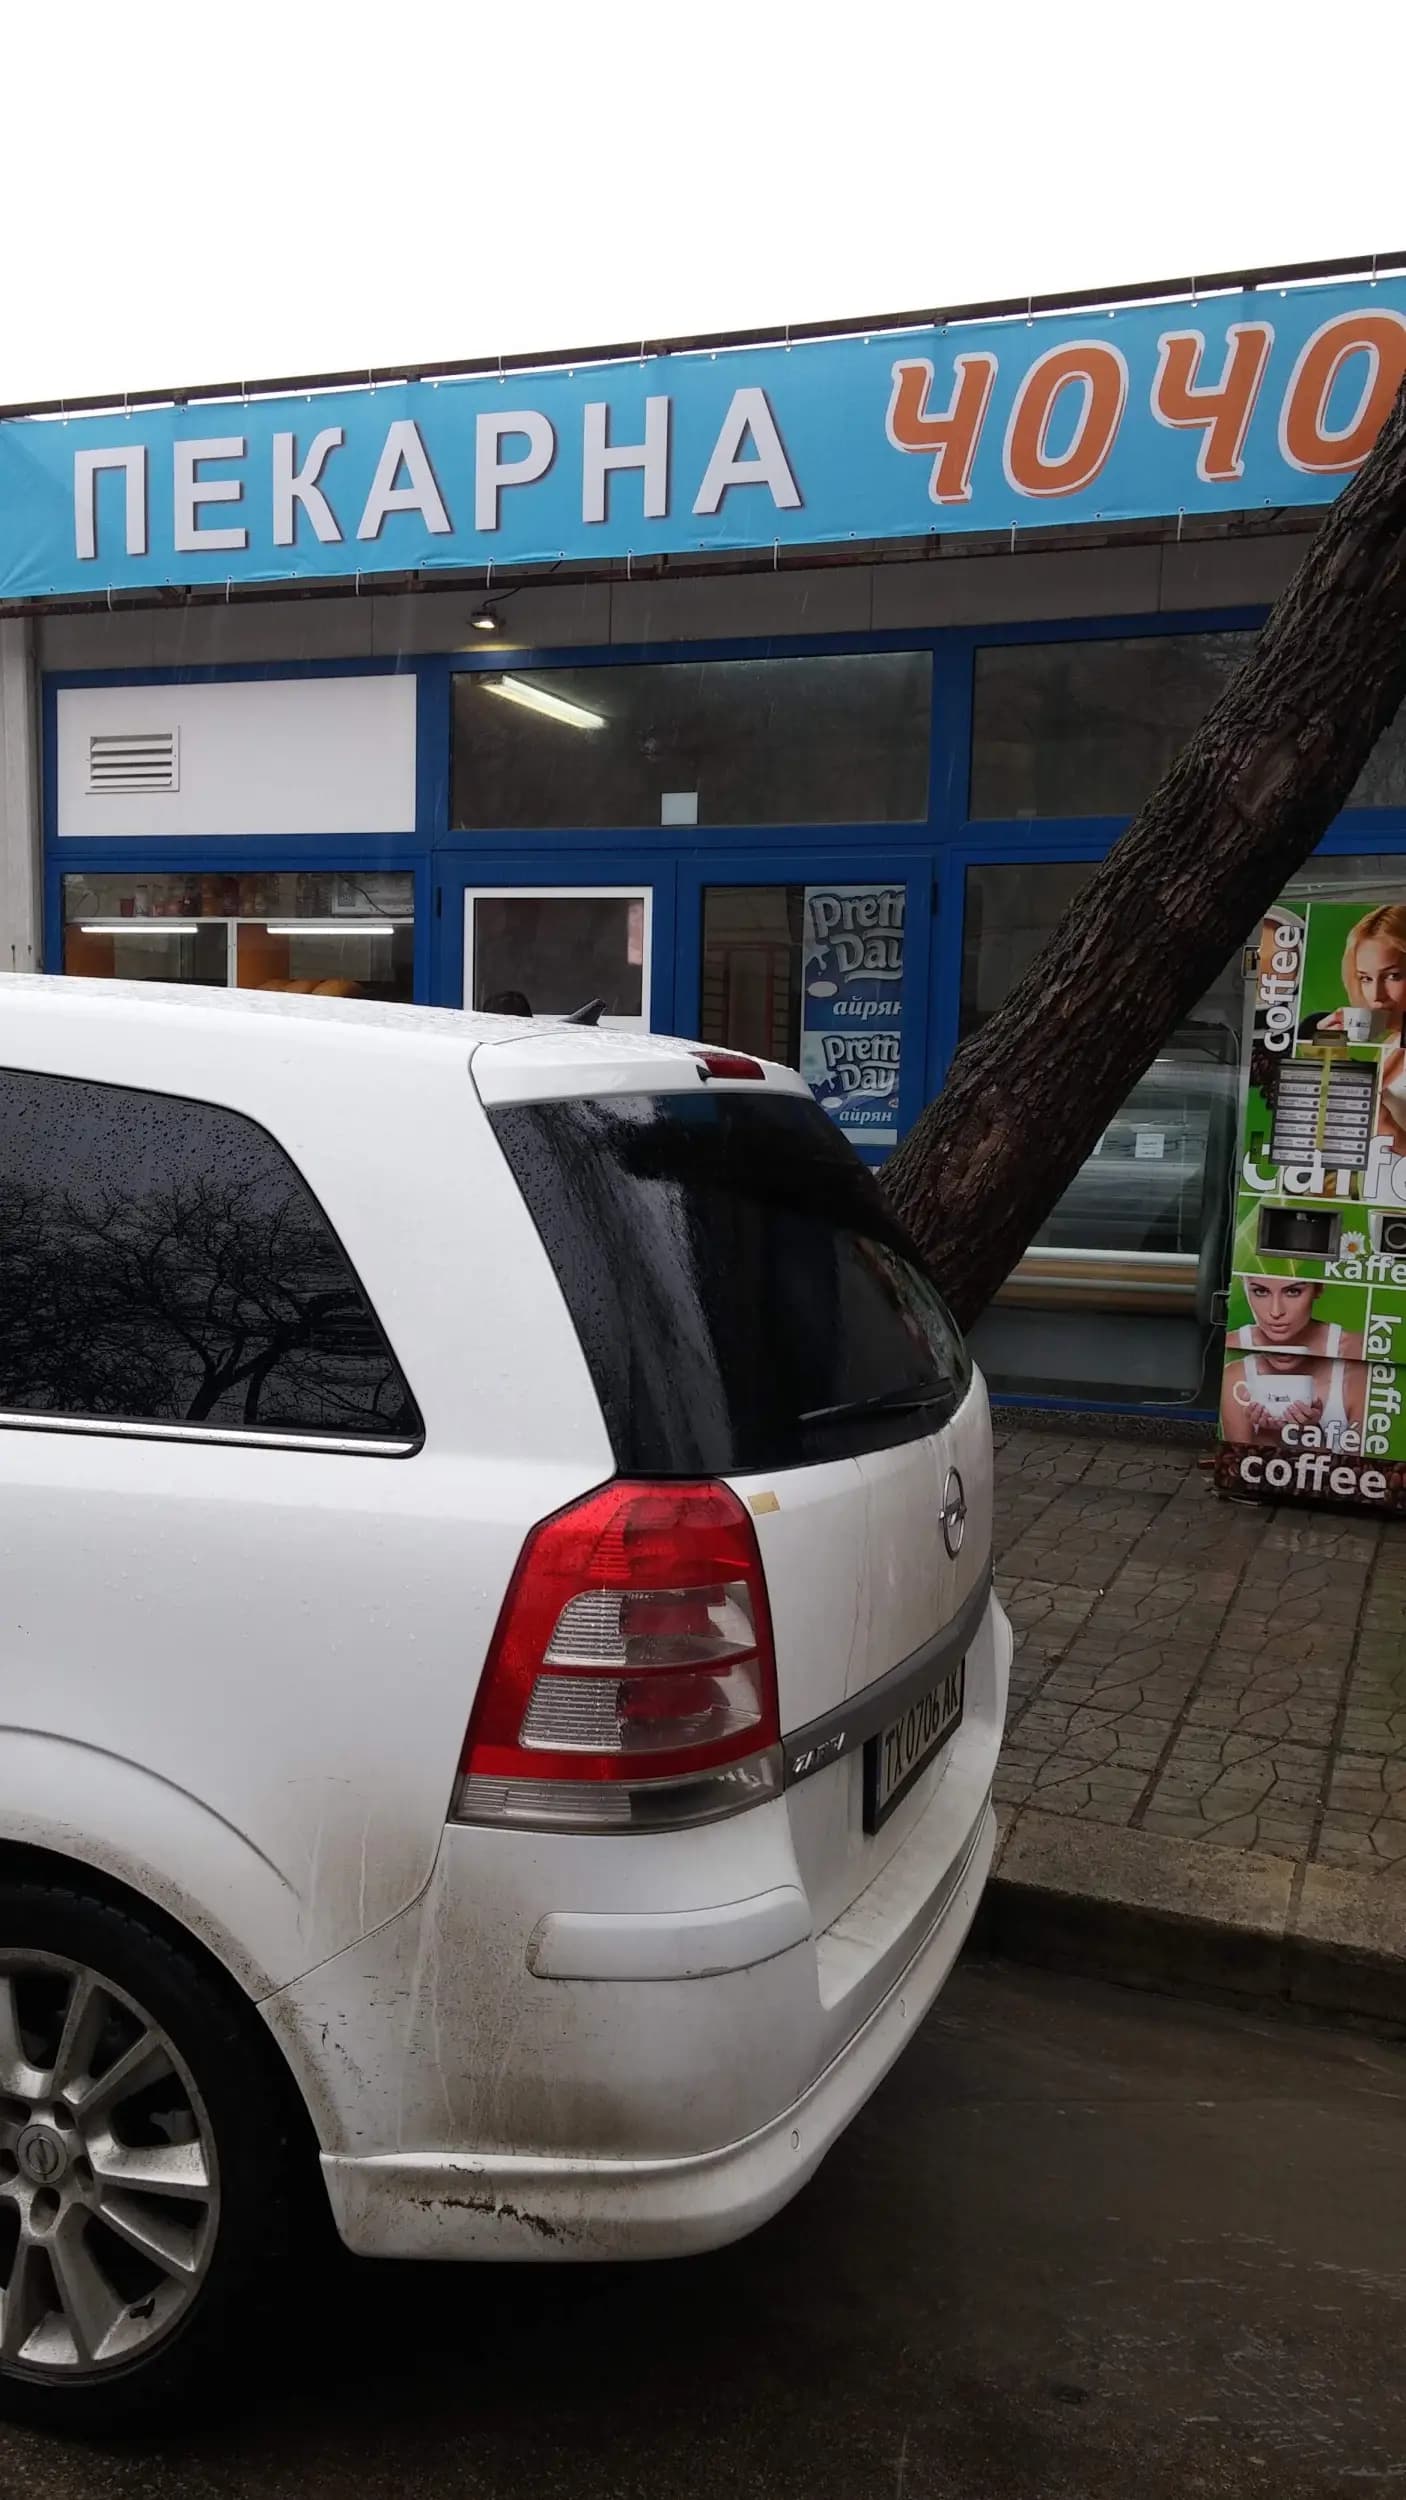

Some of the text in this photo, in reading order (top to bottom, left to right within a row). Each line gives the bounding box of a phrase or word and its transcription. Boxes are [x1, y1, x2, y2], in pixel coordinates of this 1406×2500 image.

[73, 386, 804, 560] ПЕКАРНА
[1259, 924, 1301, 1053] coffee
[837, 1063, 896, 1098] Day
[839, 1107, 893, 1125] айрян
[1280, 1419, 1362, 1452] café
[1239, 1452, 1388, 1500] coffee
